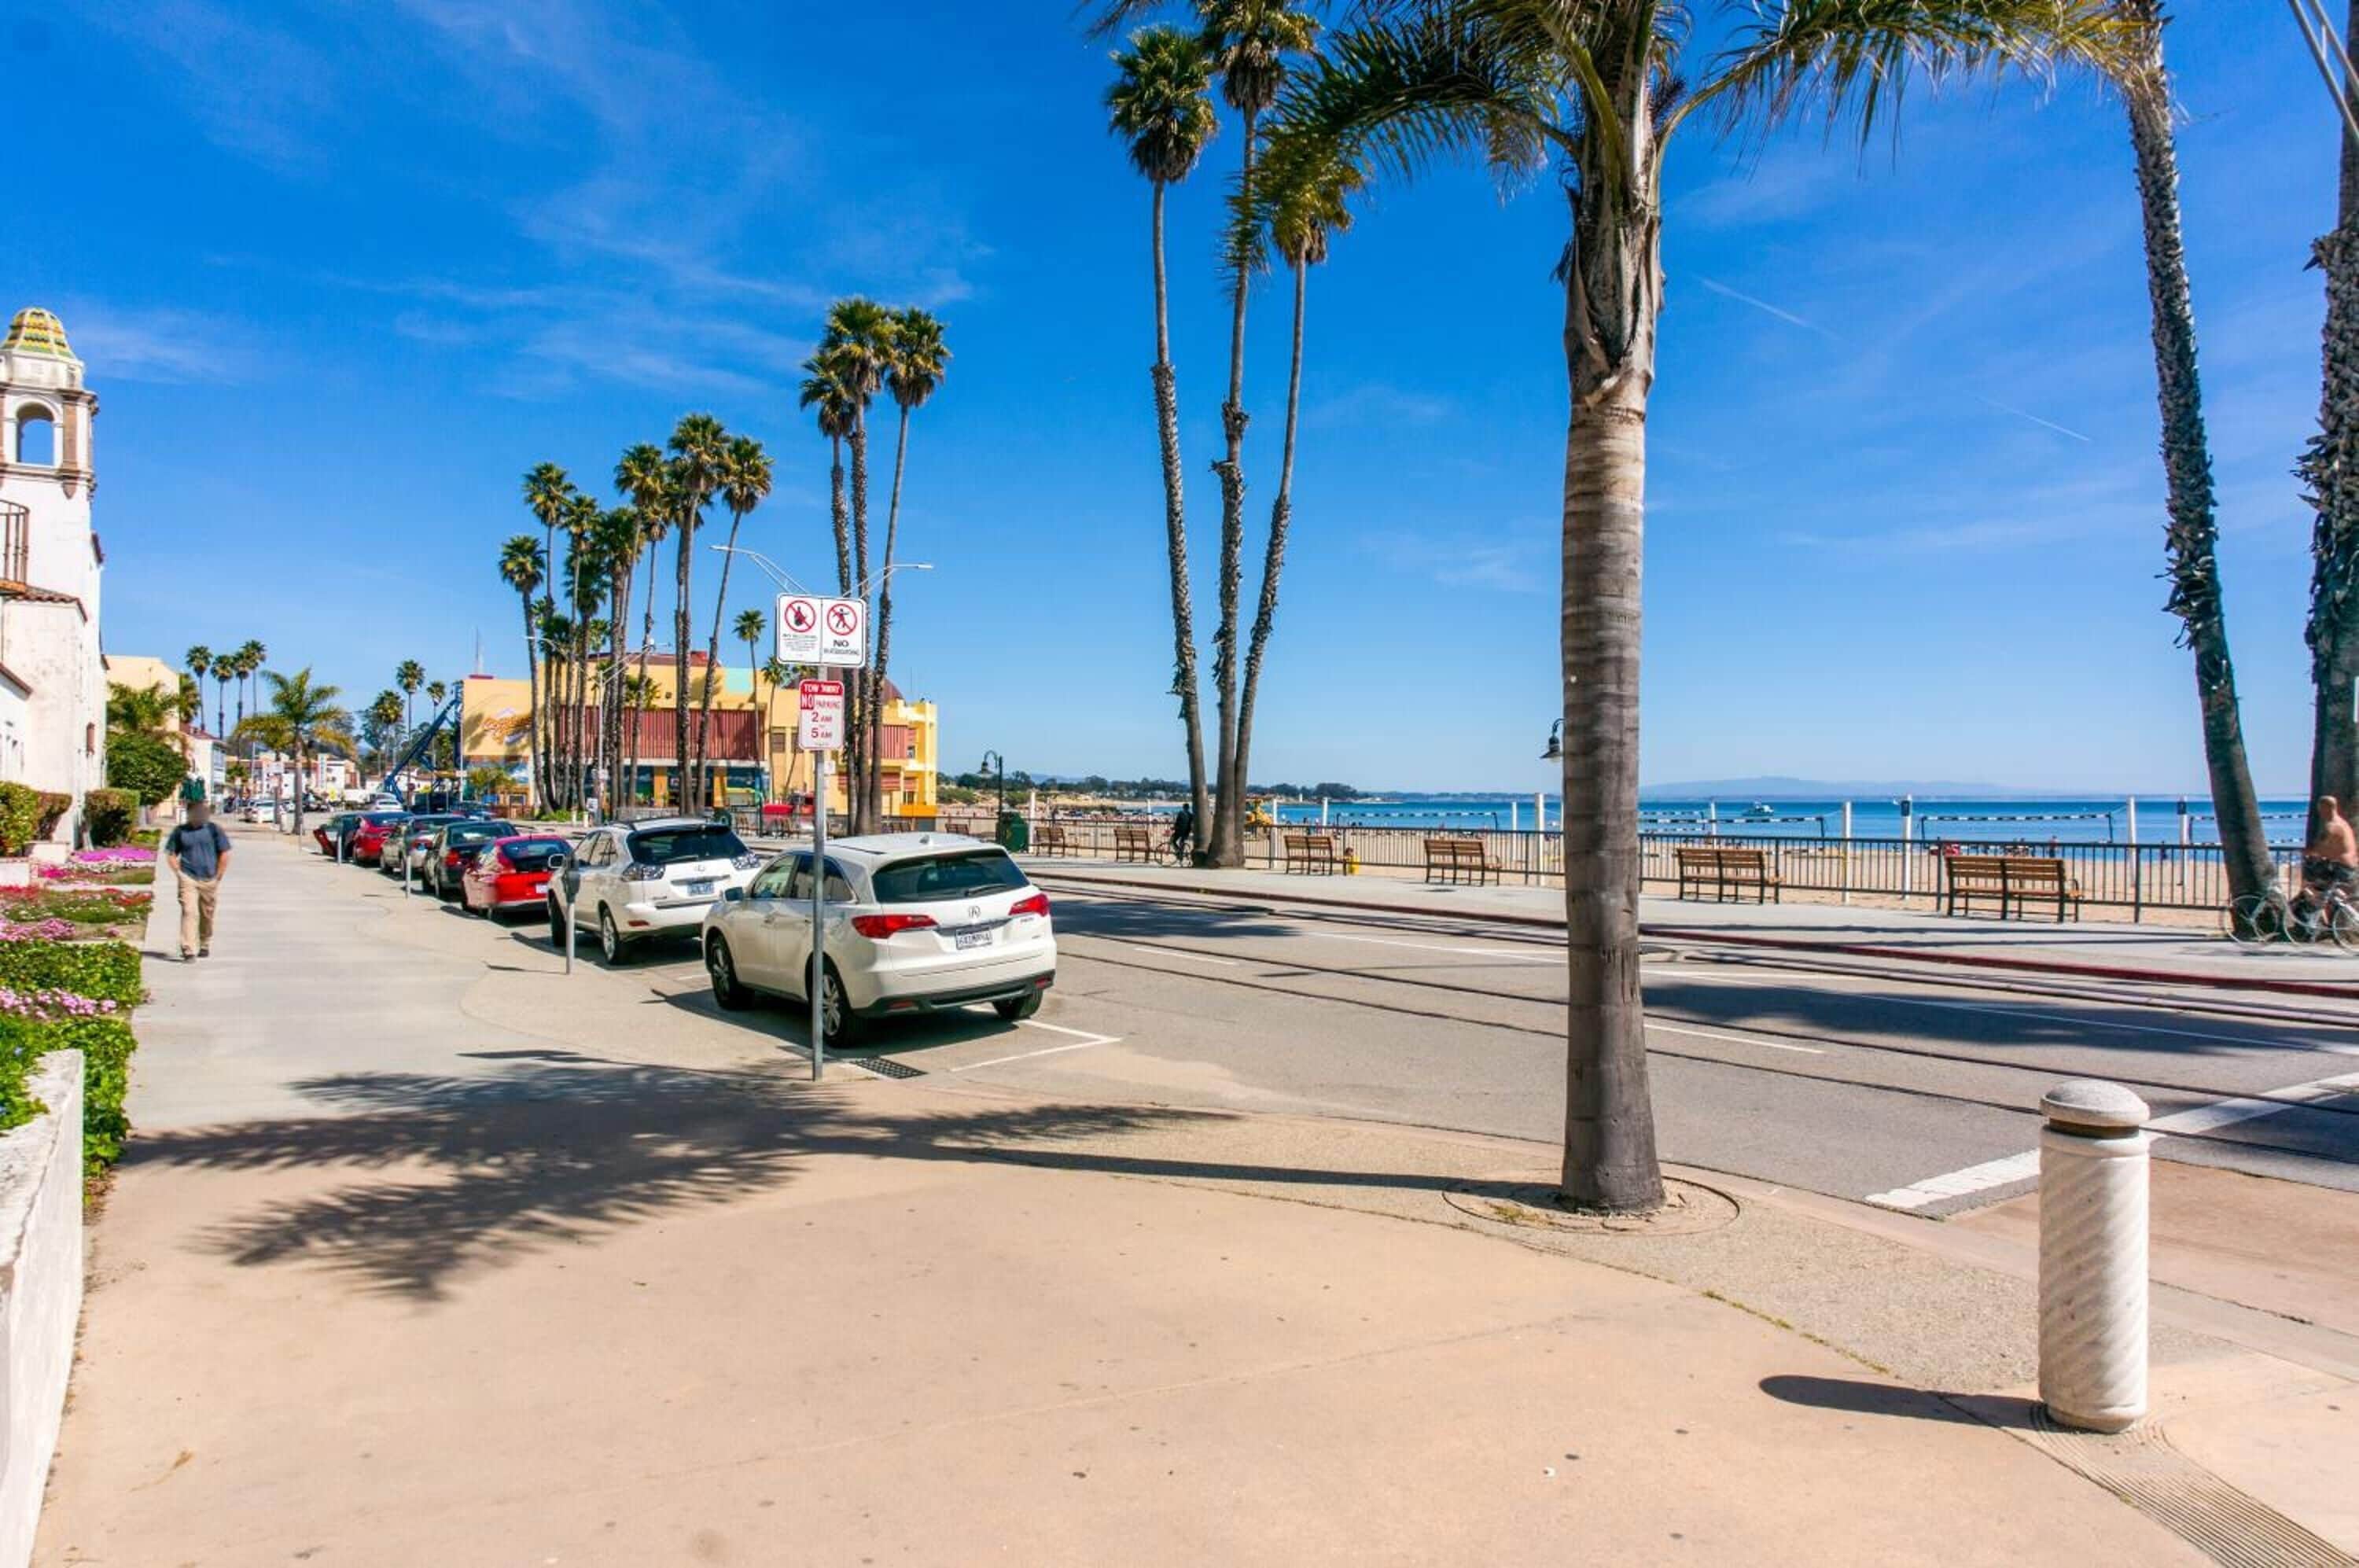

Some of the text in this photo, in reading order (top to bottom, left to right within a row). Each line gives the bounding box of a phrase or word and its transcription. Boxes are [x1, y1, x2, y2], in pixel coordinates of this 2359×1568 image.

[804, 683, 819, 693] TOW
[801, 694, 813, 709] NO
[811, 712, 819, 723] 2
[811, 727, 819, 738] 5
